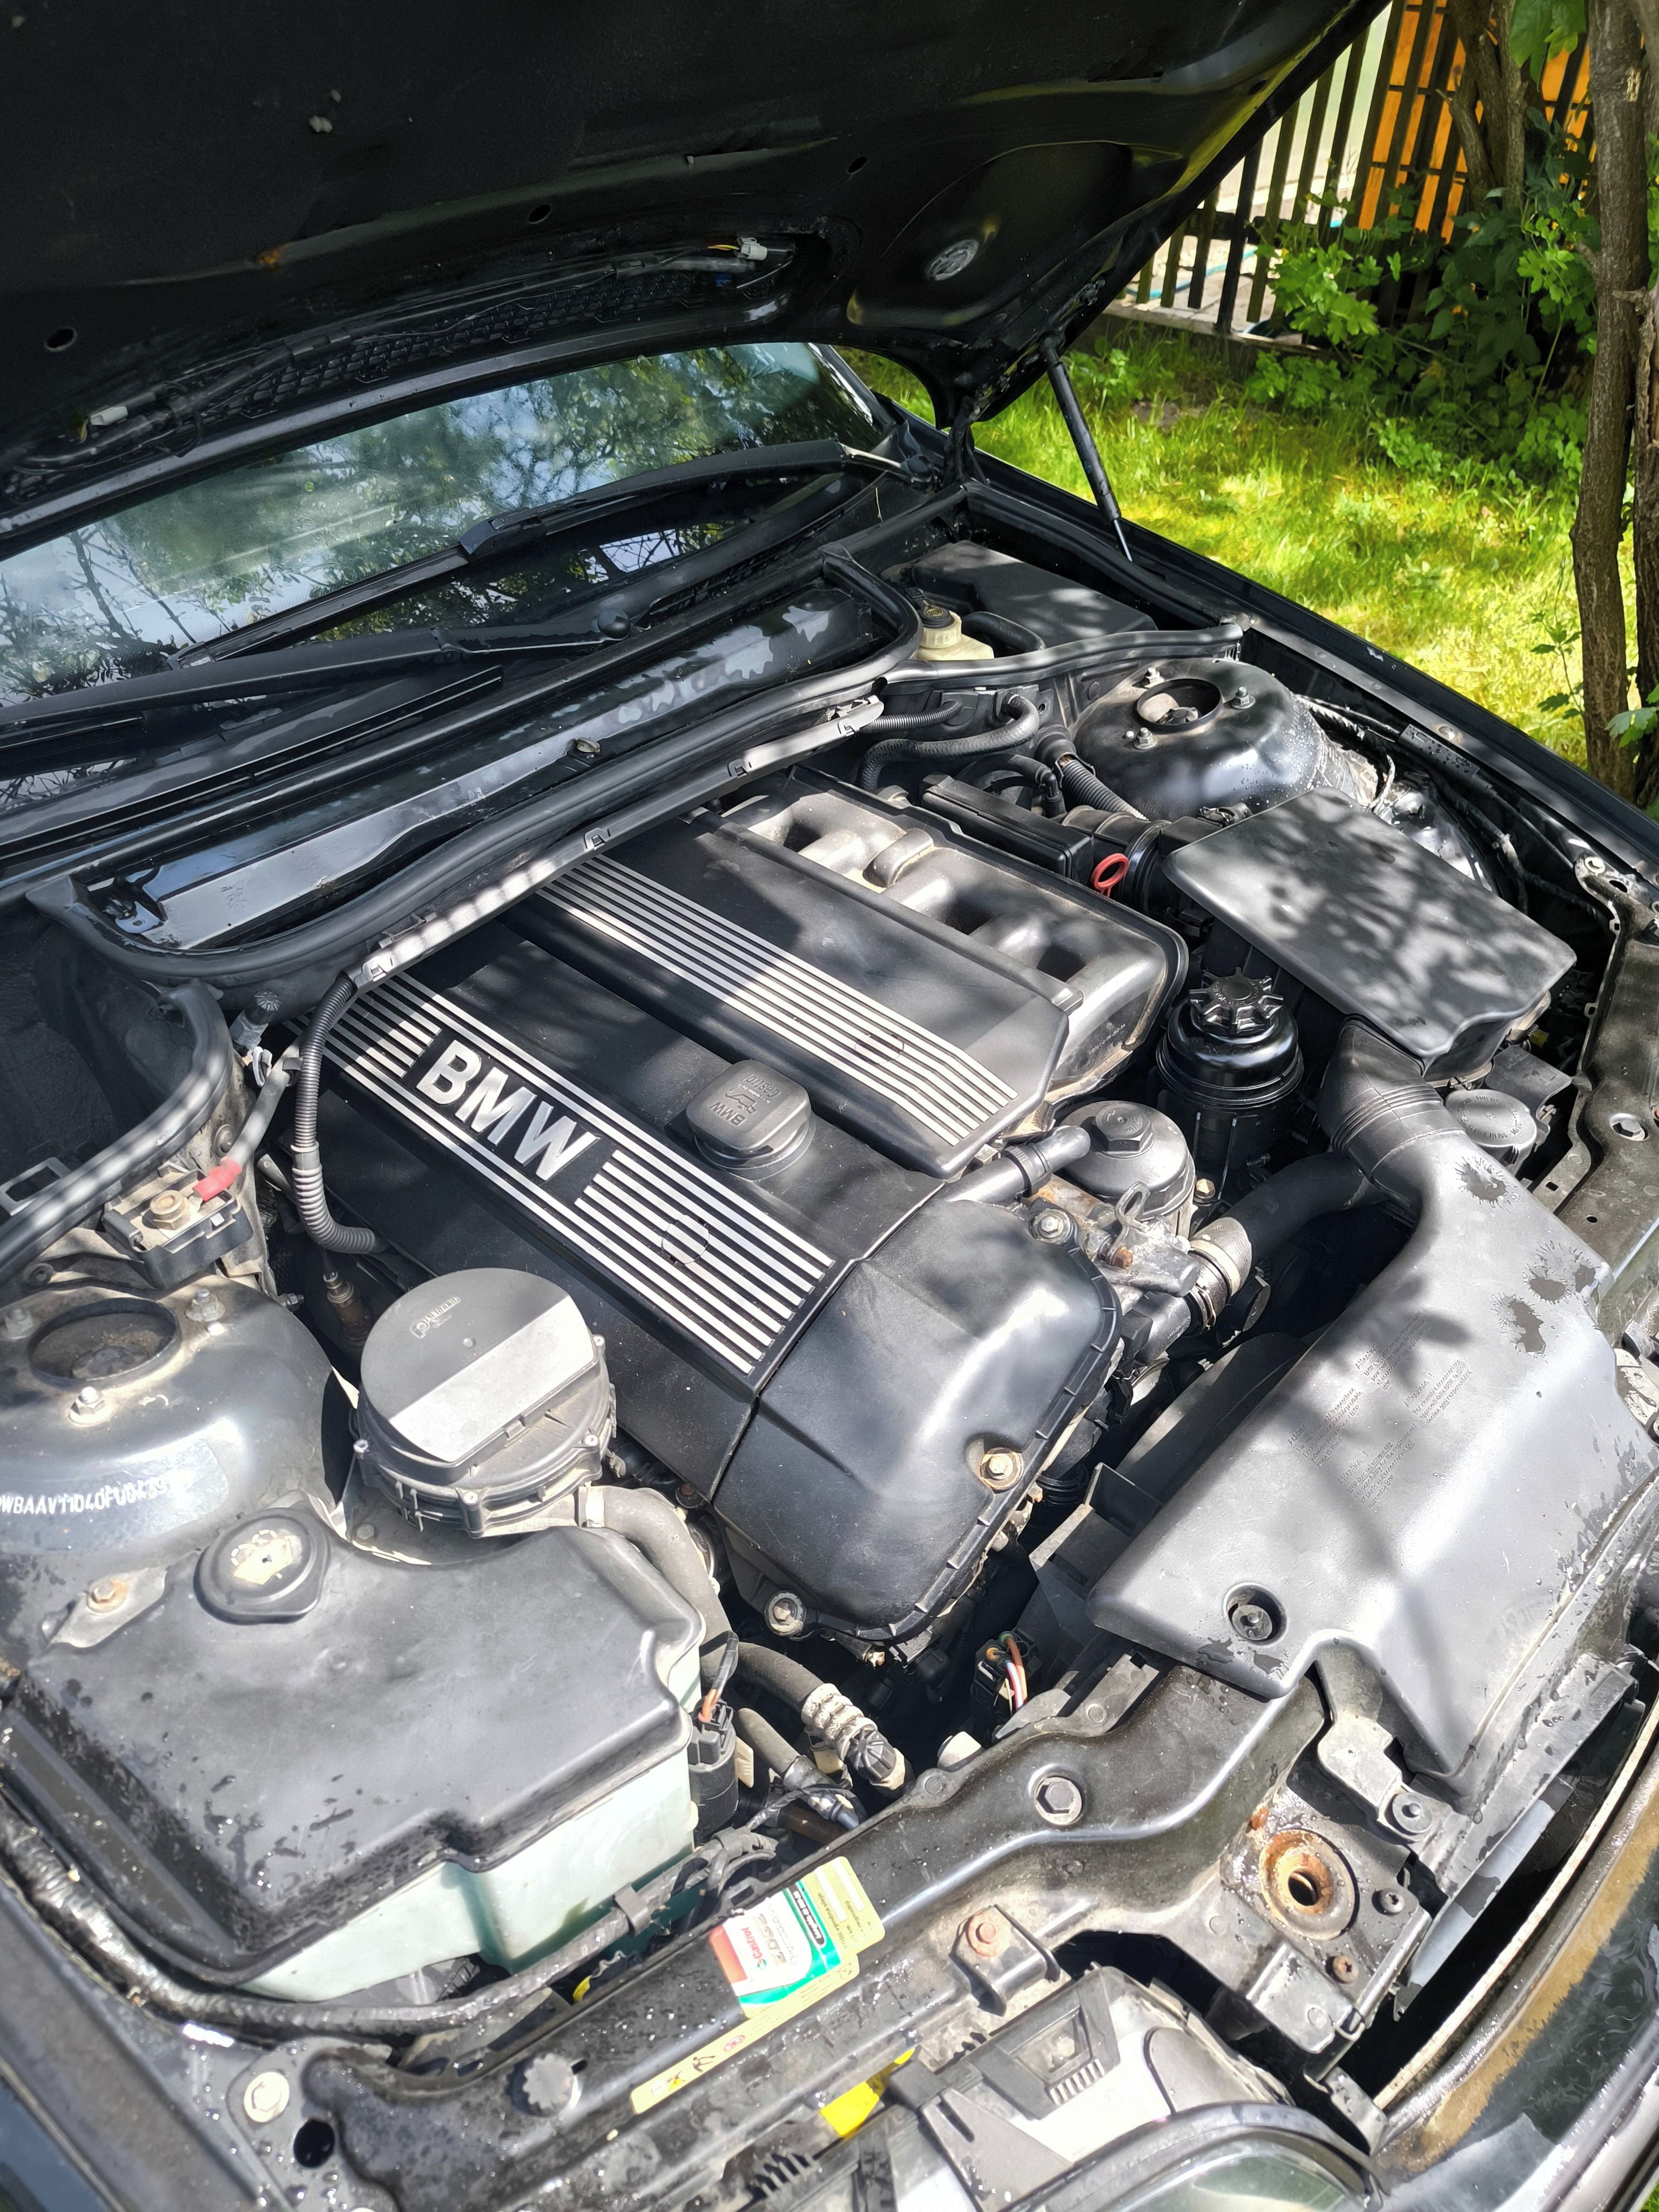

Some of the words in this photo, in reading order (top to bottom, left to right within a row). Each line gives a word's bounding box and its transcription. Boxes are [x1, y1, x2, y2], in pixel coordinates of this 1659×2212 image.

[741, 1074, 781, 1098] Castrol
[416, 1040, 601, 1181] BMW
[709, 1101, 748, 1127] BMW
[738, 1925, 764, 1960] Castrol
[751, 1912, 788, 1967] EDGE
